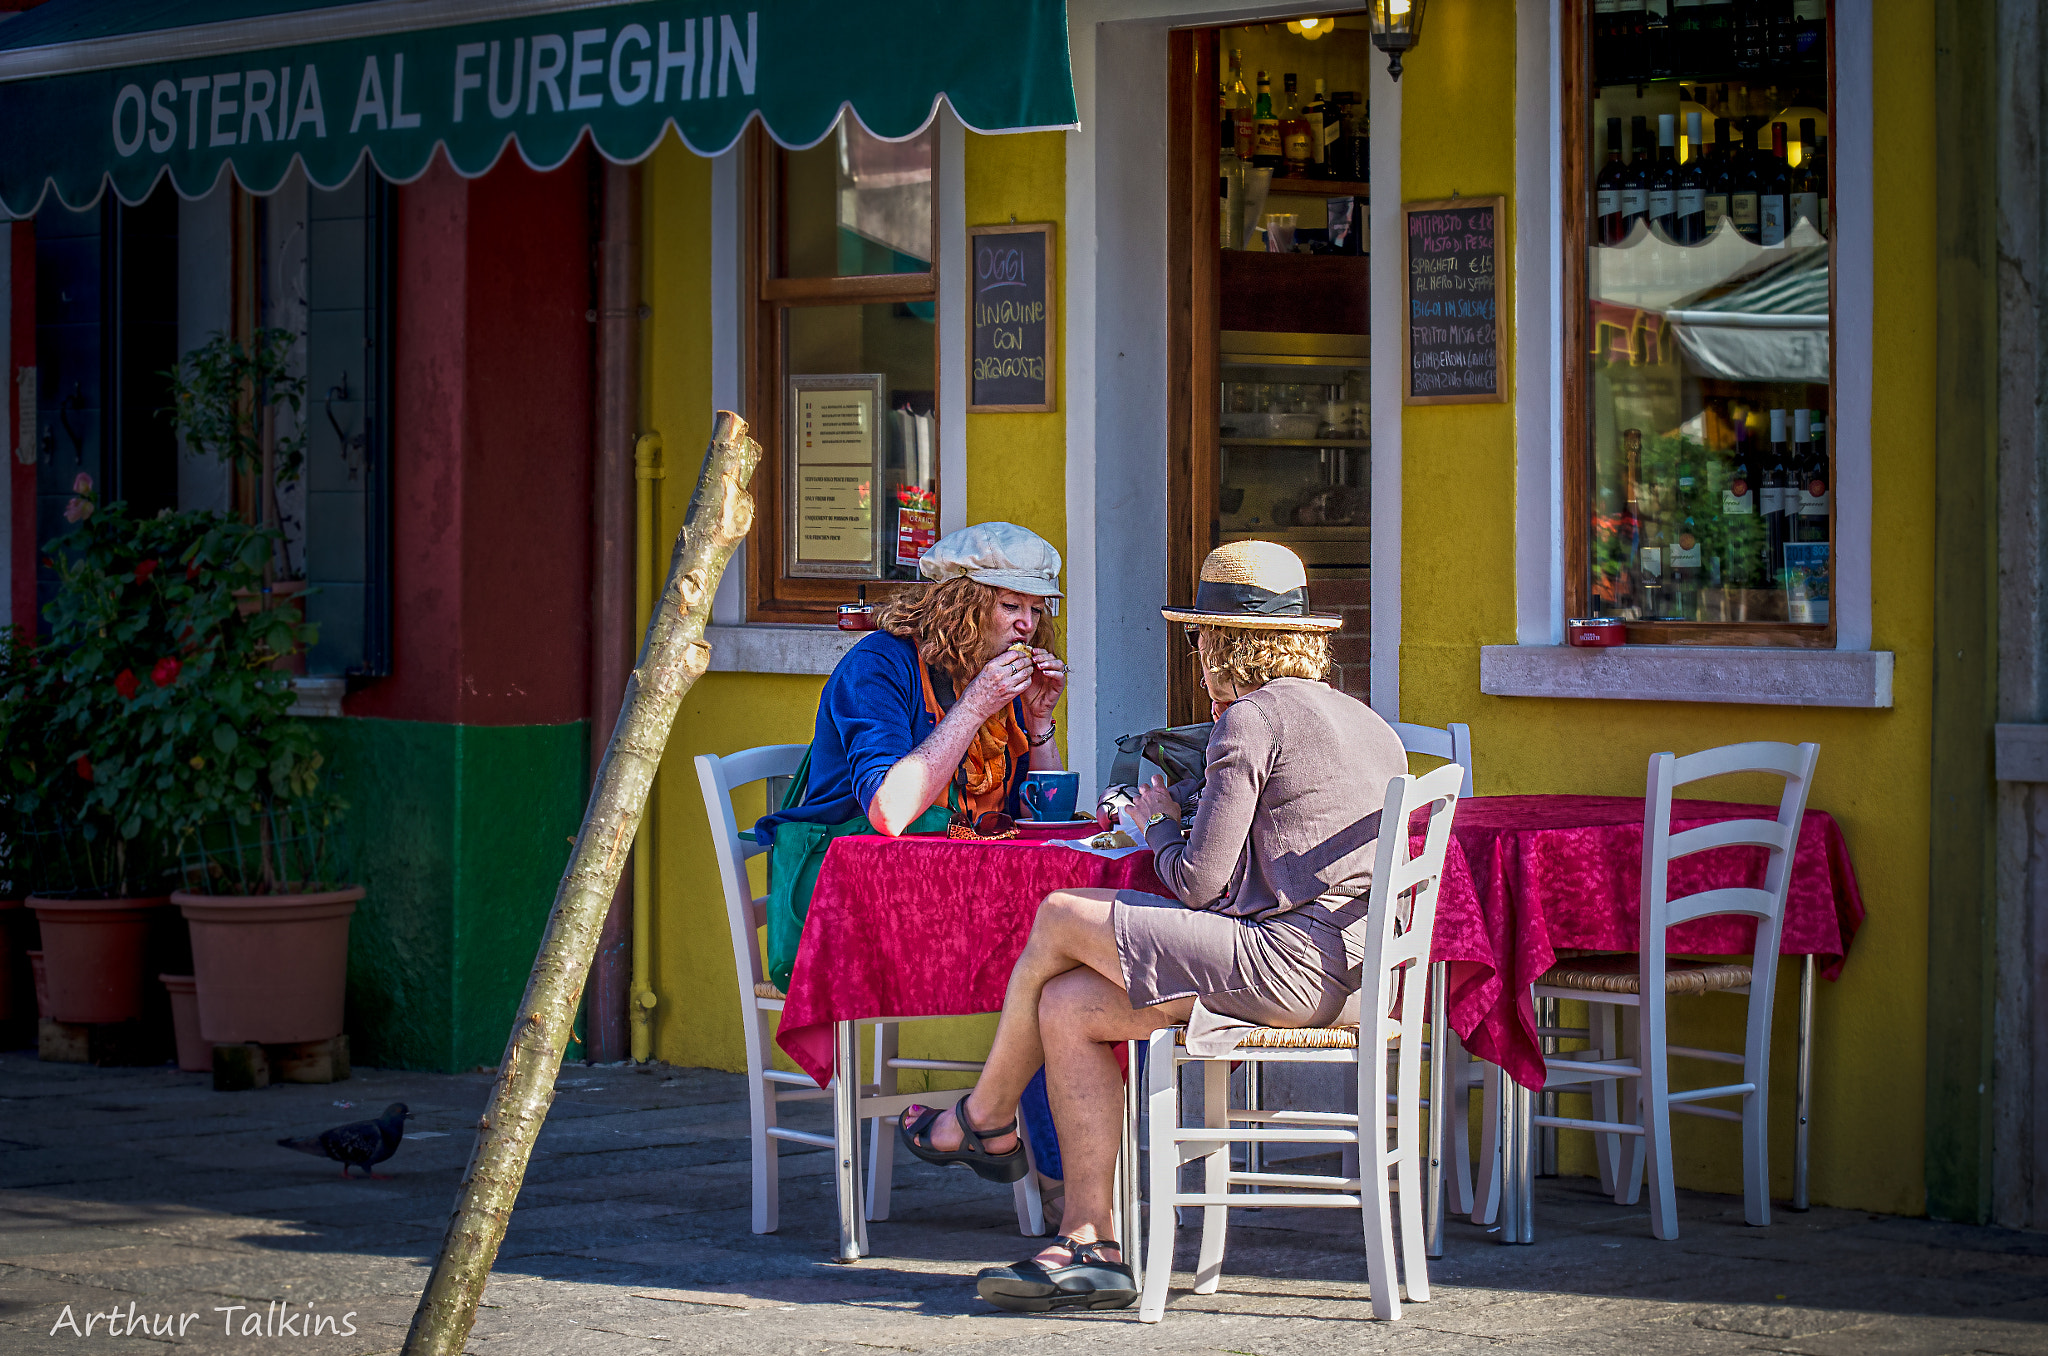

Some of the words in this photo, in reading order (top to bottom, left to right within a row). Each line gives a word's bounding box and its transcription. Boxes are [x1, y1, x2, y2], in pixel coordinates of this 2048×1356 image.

[112, 64, 327, 157] OSTERIA
[349, 53, 421, 134] AL
[453, 12, 757, 122] FUREGHIN
[1410, 214, 1462, 238] ANTIPASTO
[1424, 236, 1452, 253] MISTO
[978, 246, 1025, 281] OGGI
[1411, 257, 1458, 274] SPAGHETTI
[1430, 275, 1452, 291] NERO
[993, 326, 1022, 350] CON
[1412, 325, 1447, 346] FRITTO
[1449, 325, 1475, 345] MISTO
[1413, 350, 1467, 370] GAMBERONI
